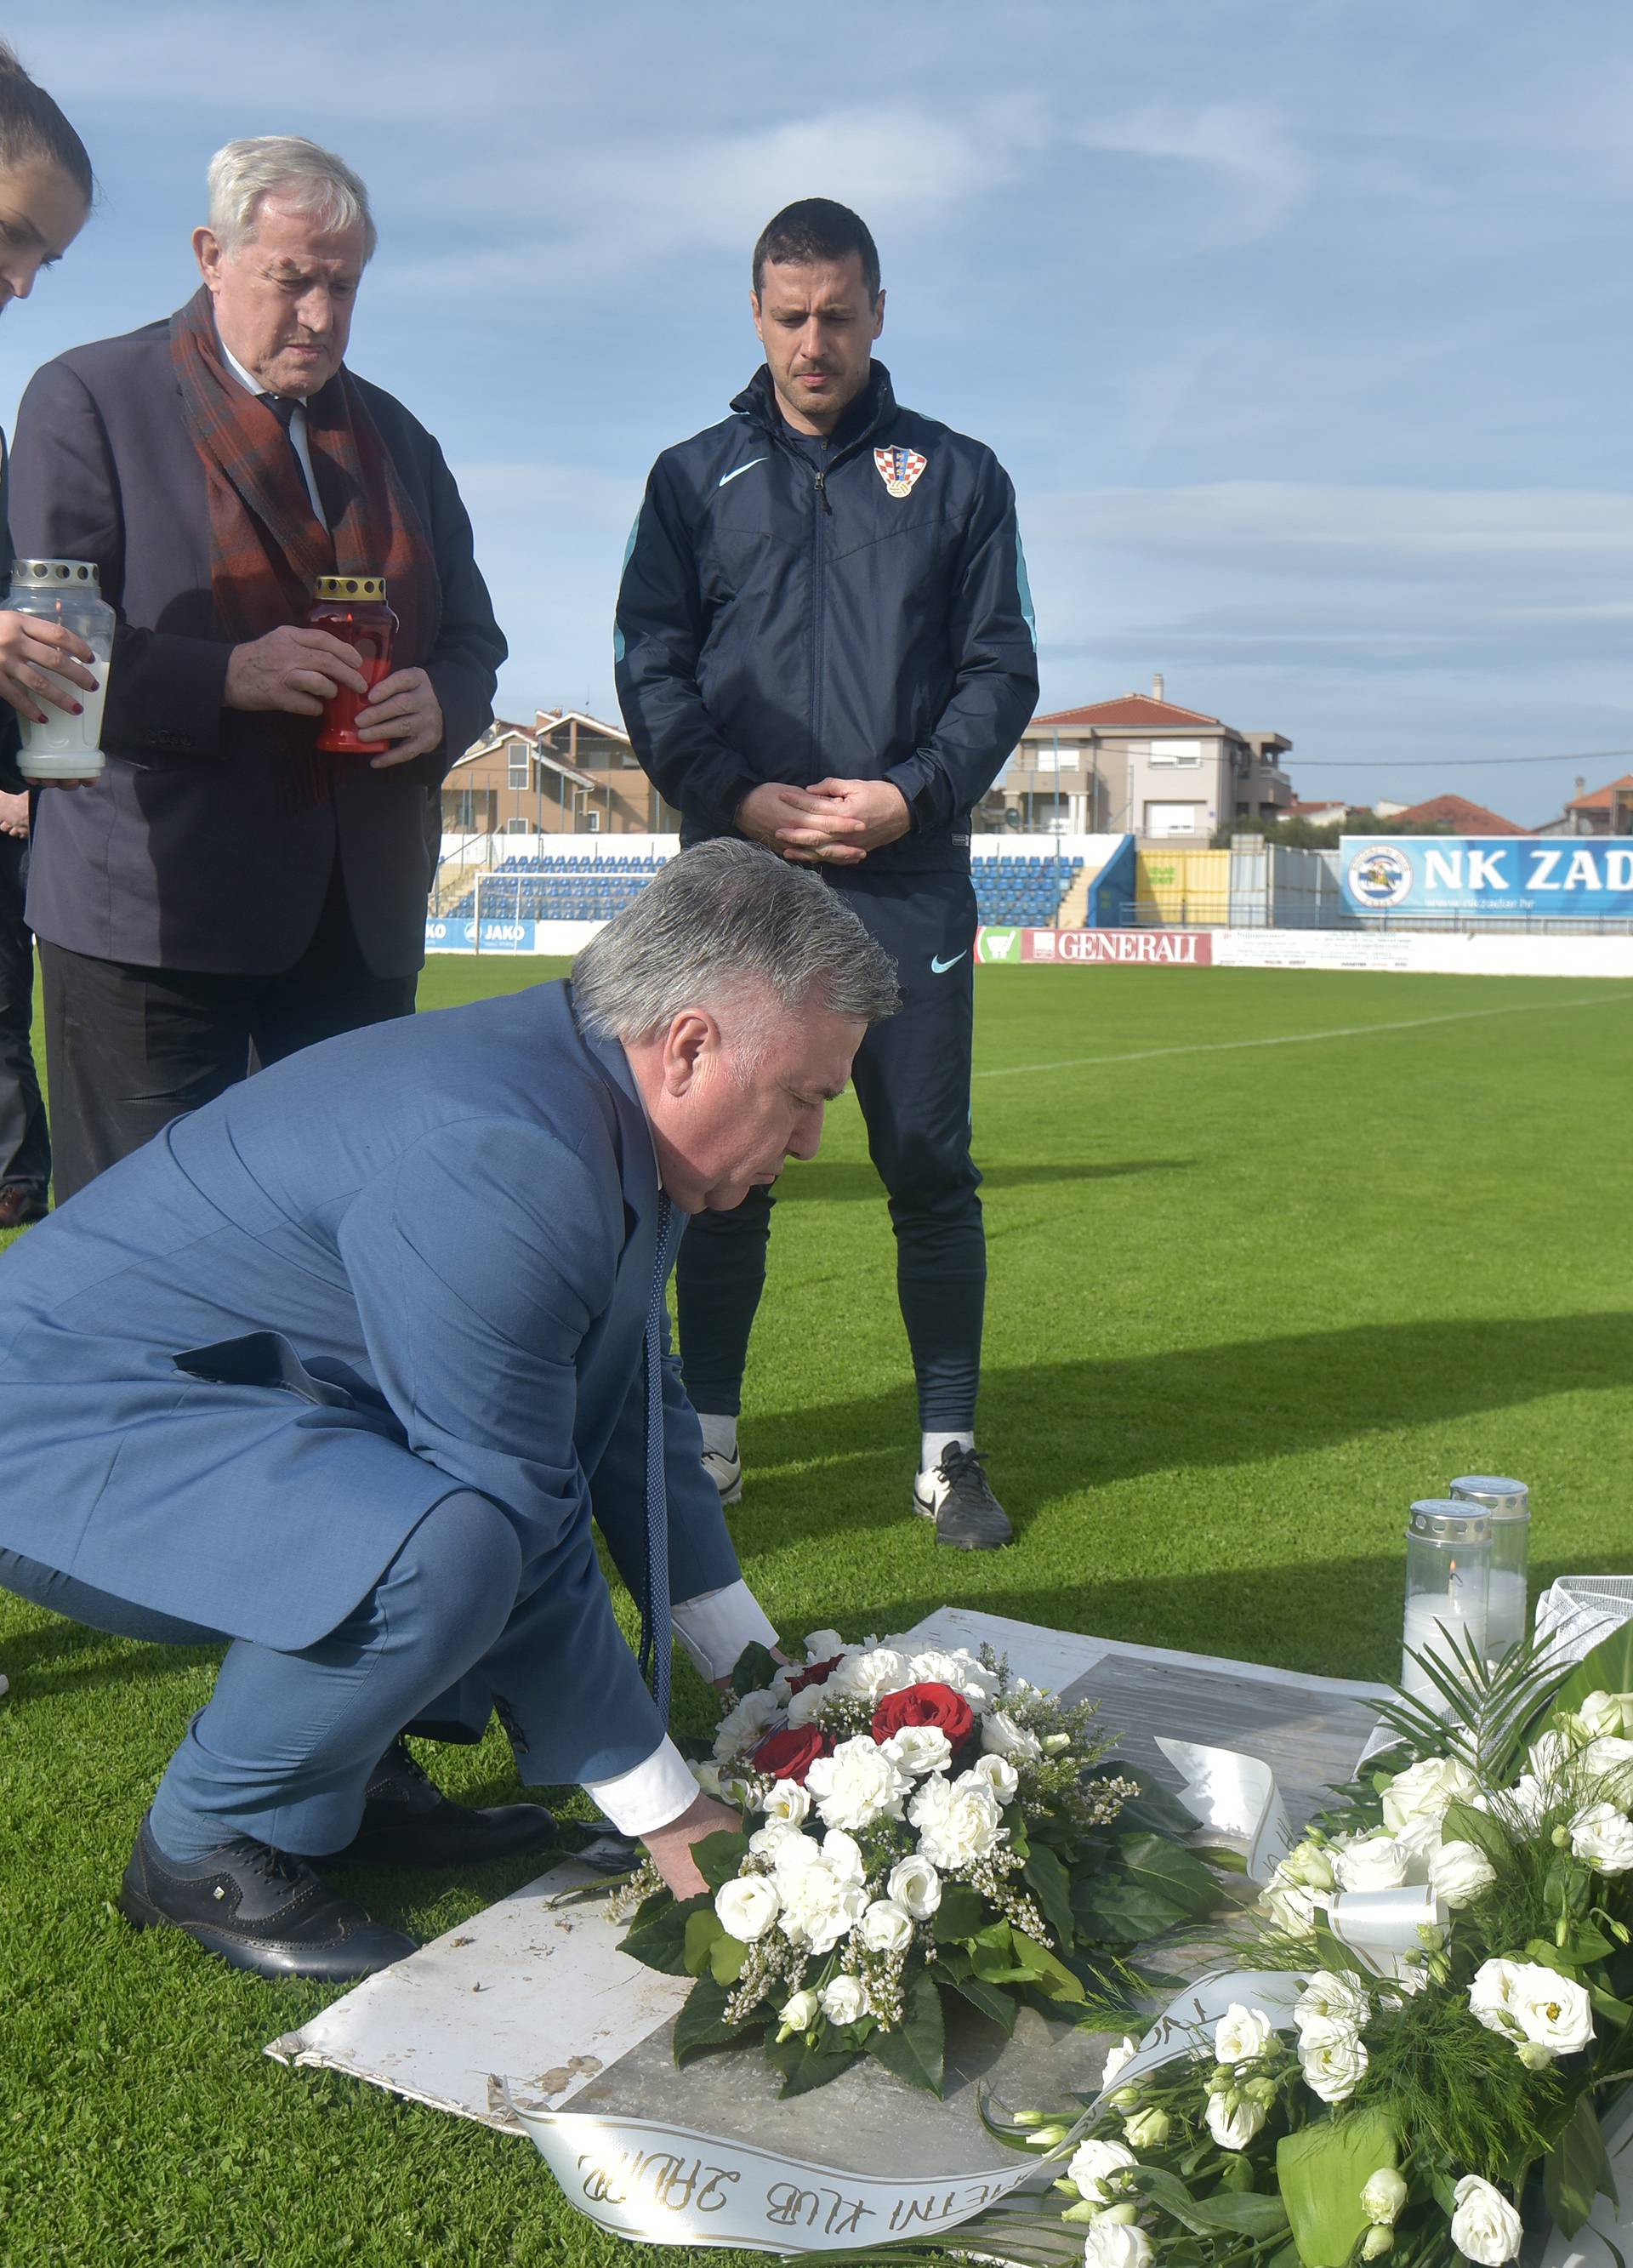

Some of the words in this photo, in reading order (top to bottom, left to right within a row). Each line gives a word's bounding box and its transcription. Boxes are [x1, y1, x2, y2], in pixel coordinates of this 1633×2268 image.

[1424, 850, 1510, 890] NK
[1526, 850, 1633, 891] ZAD
[425, 924, 447, 939] KO
[485, 925, 525, 941] JAKO
[1058, 932, 1198, 963] GENERALI
[765, 2182, 876, 2235] KLUB
